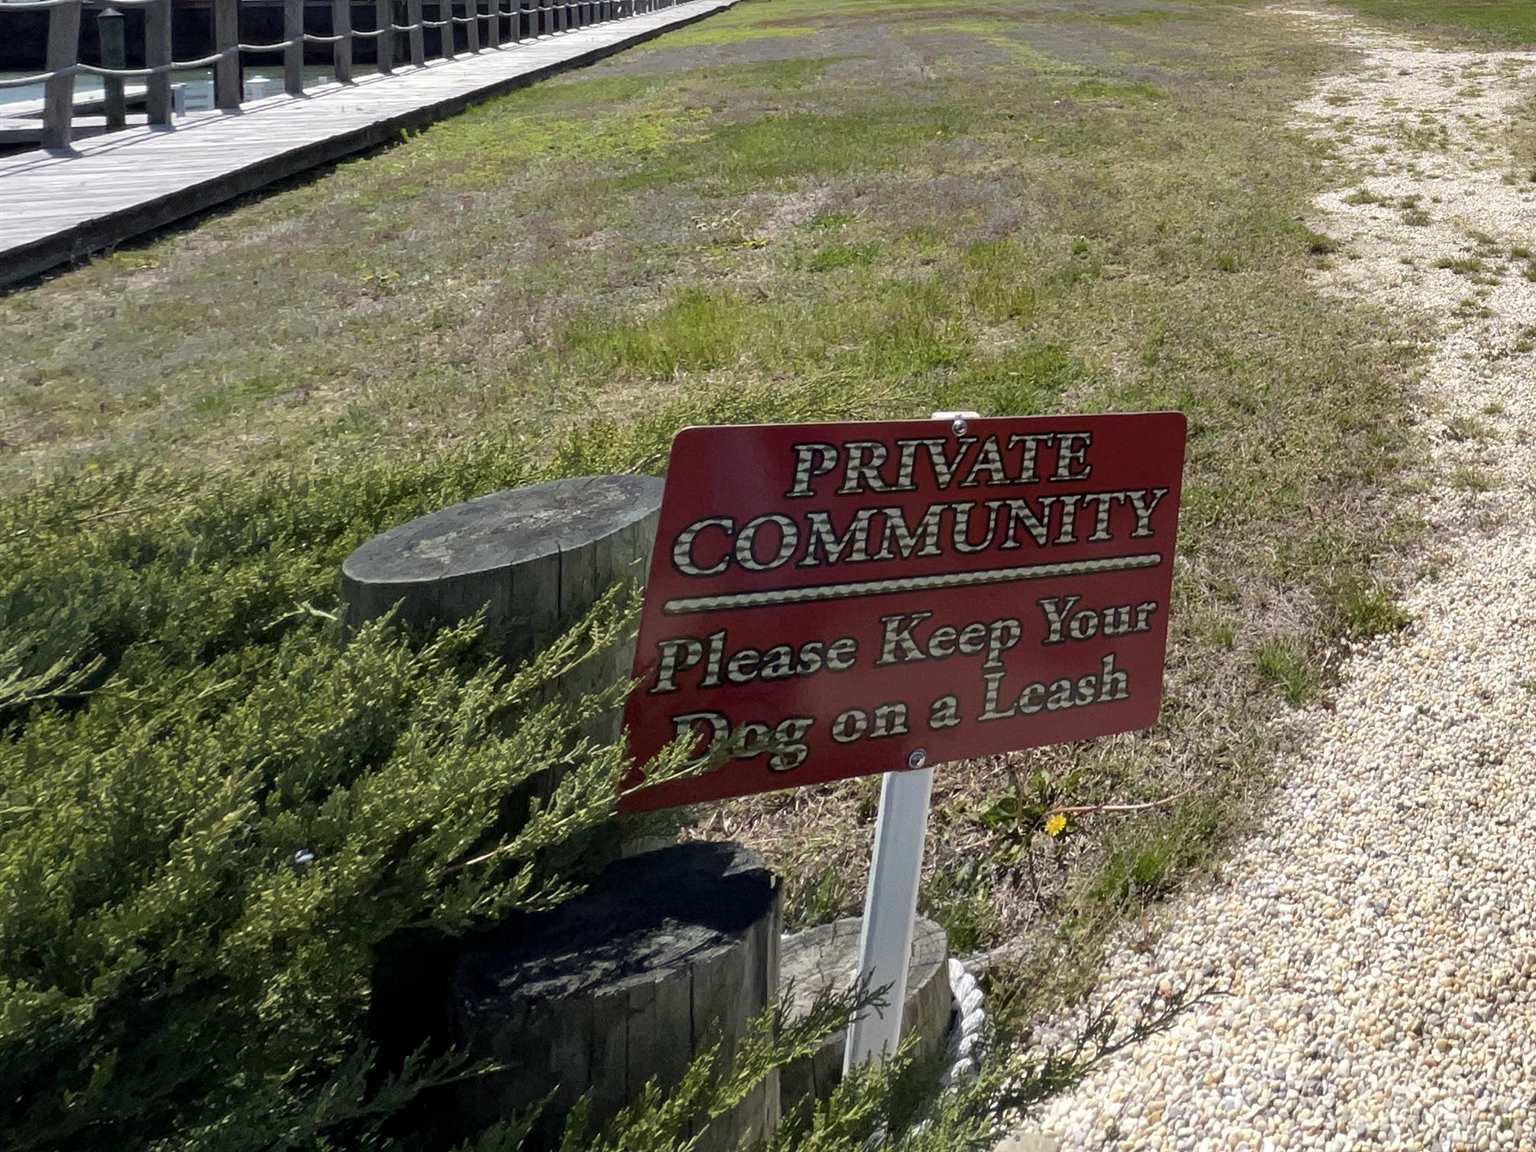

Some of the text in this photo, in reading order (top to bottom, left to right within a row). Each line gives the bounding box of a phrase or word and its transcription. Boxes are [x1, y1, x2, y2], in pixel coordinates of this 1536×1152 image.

[786, 432, 1093, 498] PRIVATE
[671, 488, 1168, 578] COMMUNITY
[650, 596, 1159, 695] Please Keep Your
[831, 703, 908, 746] on
[929, 694, 962, 730] a
[978, 654, 1131, 723] Leash
